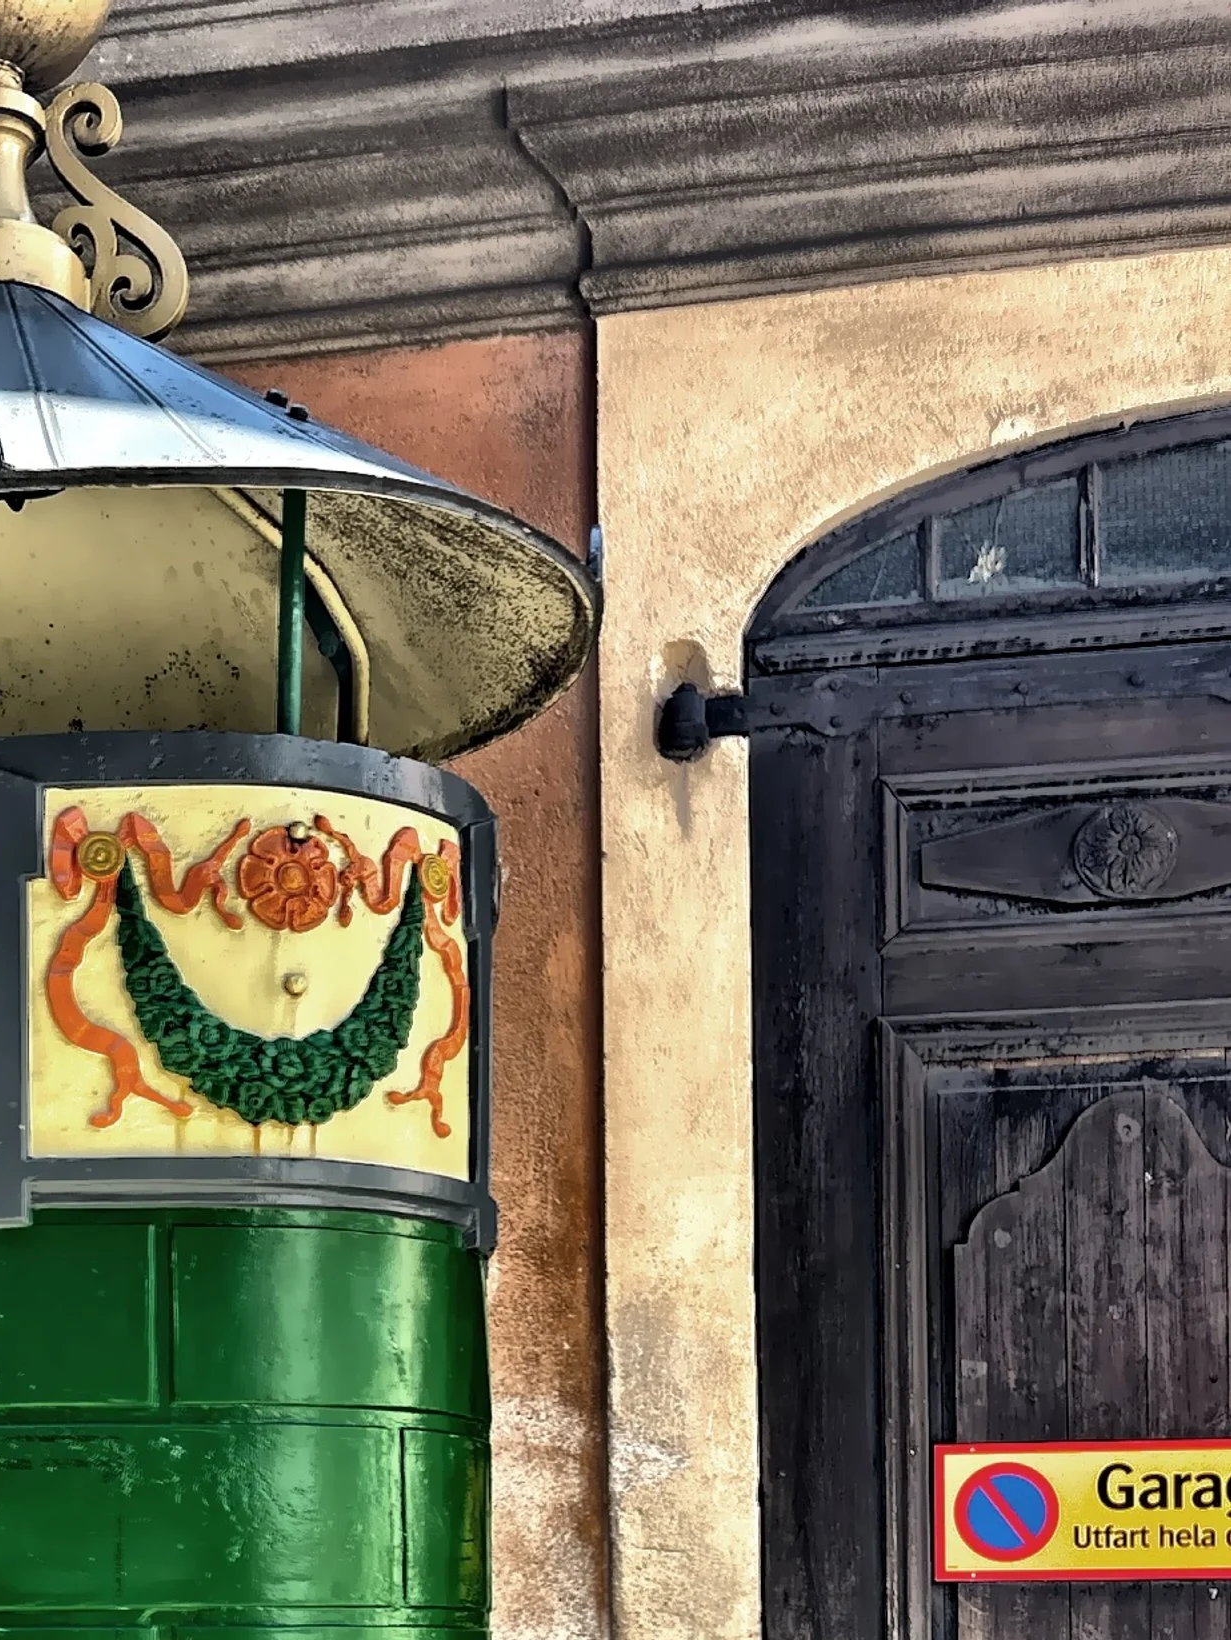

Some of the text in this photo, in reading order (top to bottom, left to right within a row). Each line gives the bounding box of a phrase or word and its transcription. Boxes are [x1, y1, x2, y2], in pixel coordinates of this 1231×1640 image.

[1097, 1462, 1231, 1518] Gara
[1074, 1523, 1150, 1549] Utfart
[1159, 1522, 1216, 1549] hela
